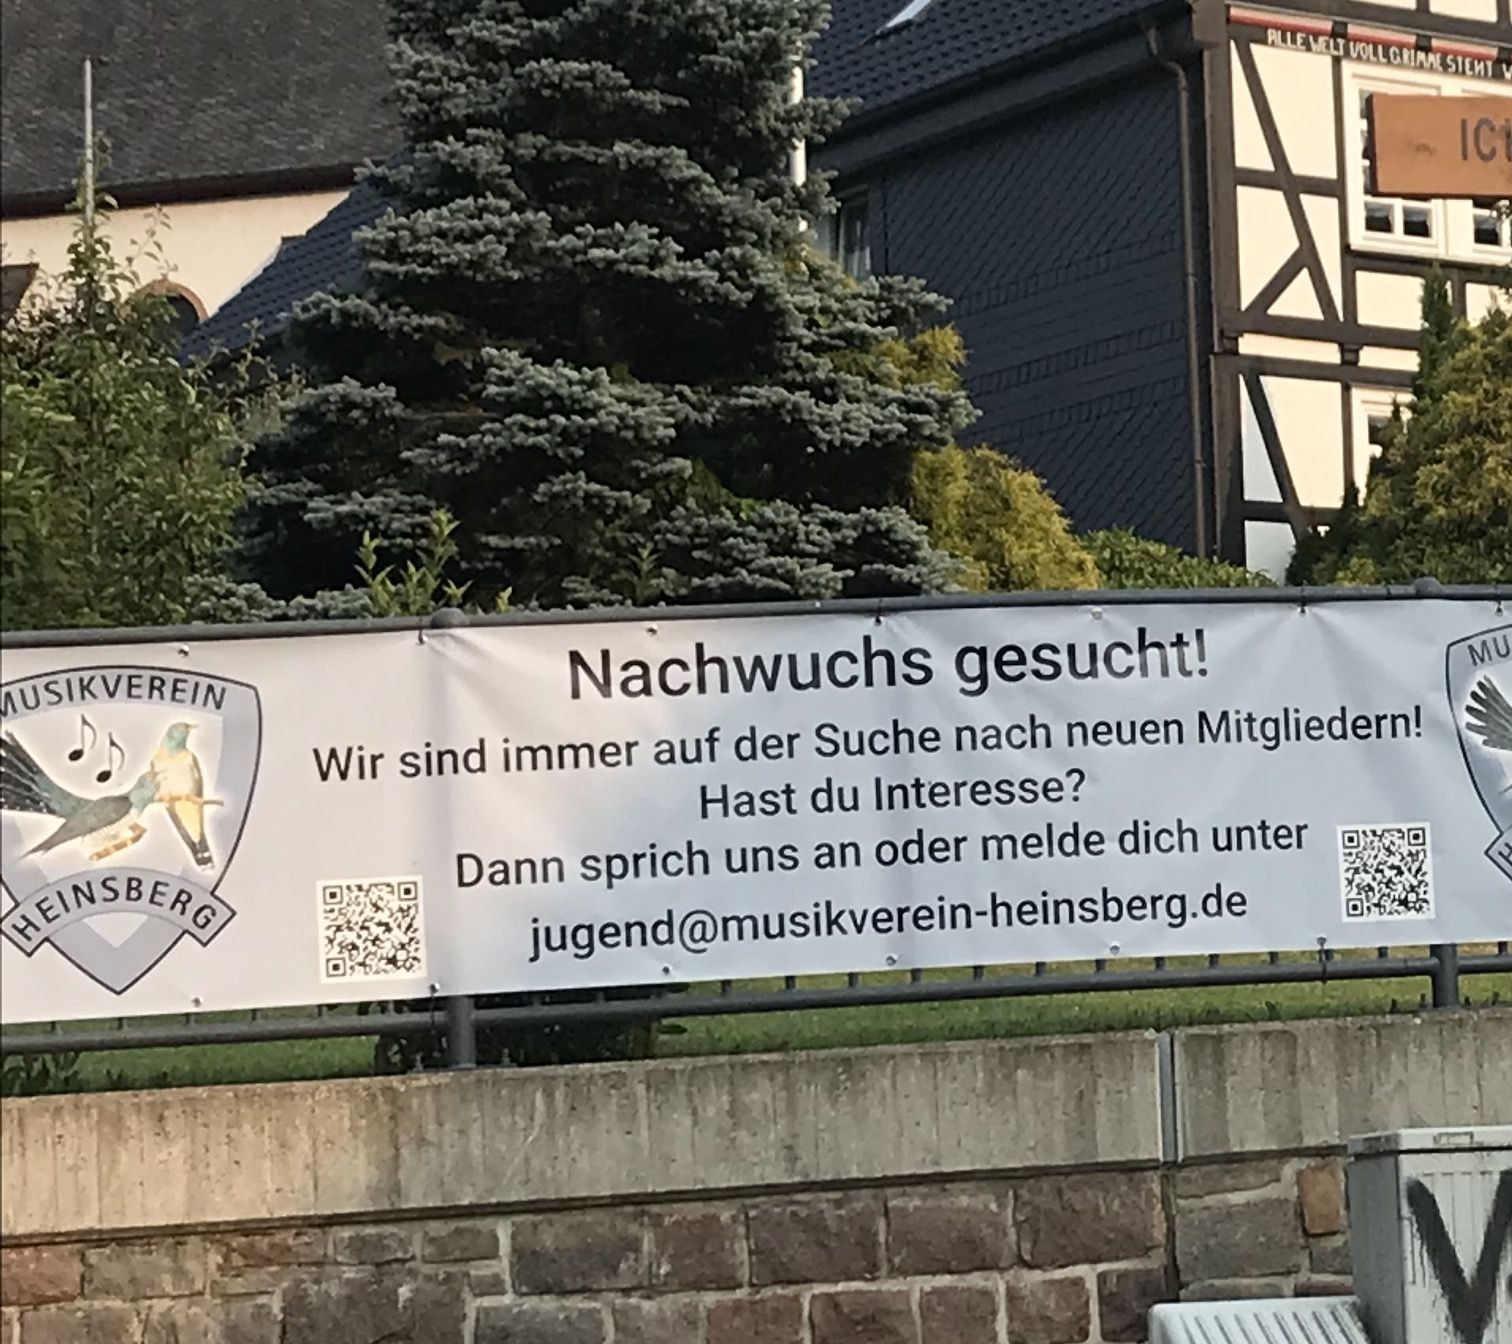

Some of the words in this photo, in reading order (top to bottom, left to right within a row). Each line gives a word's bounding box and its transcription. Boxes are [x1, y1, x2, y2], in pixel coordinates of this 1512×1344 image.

[1267, 28, 1306, 50] ALLE
[1308, 35, 1345, 57] WELT
[1350, 42, 1387, 64] VOLL
[1447, 52, 1493, 78] STEHT
[1, 674, 226, 718] MUSIKVEREIN
[568, 634, 933, 700] Nachwuchs
[954, 626, 1209, 697] gesucht!
[312, 745, 385, 782] Wir
[399, 737, 487, 778] sind
[503, 737, 640, 774] immer
[653, 726, 722, 766] auf
[733, 725, 801, 763] der
[813, 718, 942, 758] Suche
[954, 713, 1053, 753] nach
[1066, 718, 1185, 749] neuen
[1197, 704, 1423, 752] Mitgliedern!
[699, 782, 798, 820] Hast
[810, 776, 860, 814] du
[874, 767, 1086, 812] Interesse?
[456, 853, 565, 889] Dann
[579, 840, 711, 890] sprich
[724, 843, 800, 875] uns
[813, 841, 863, 871] an
[874, 827, 971, 868] oder
[980, 821, 1106, 862] melde
[1117, 817, 1200, 856] dich
[1211, 818, 1310, 853] unter
[12, 874, 218, 944] HEINSBERG
[529, 882, 1249, 963] jugend@musikverein-heinsberg.de
